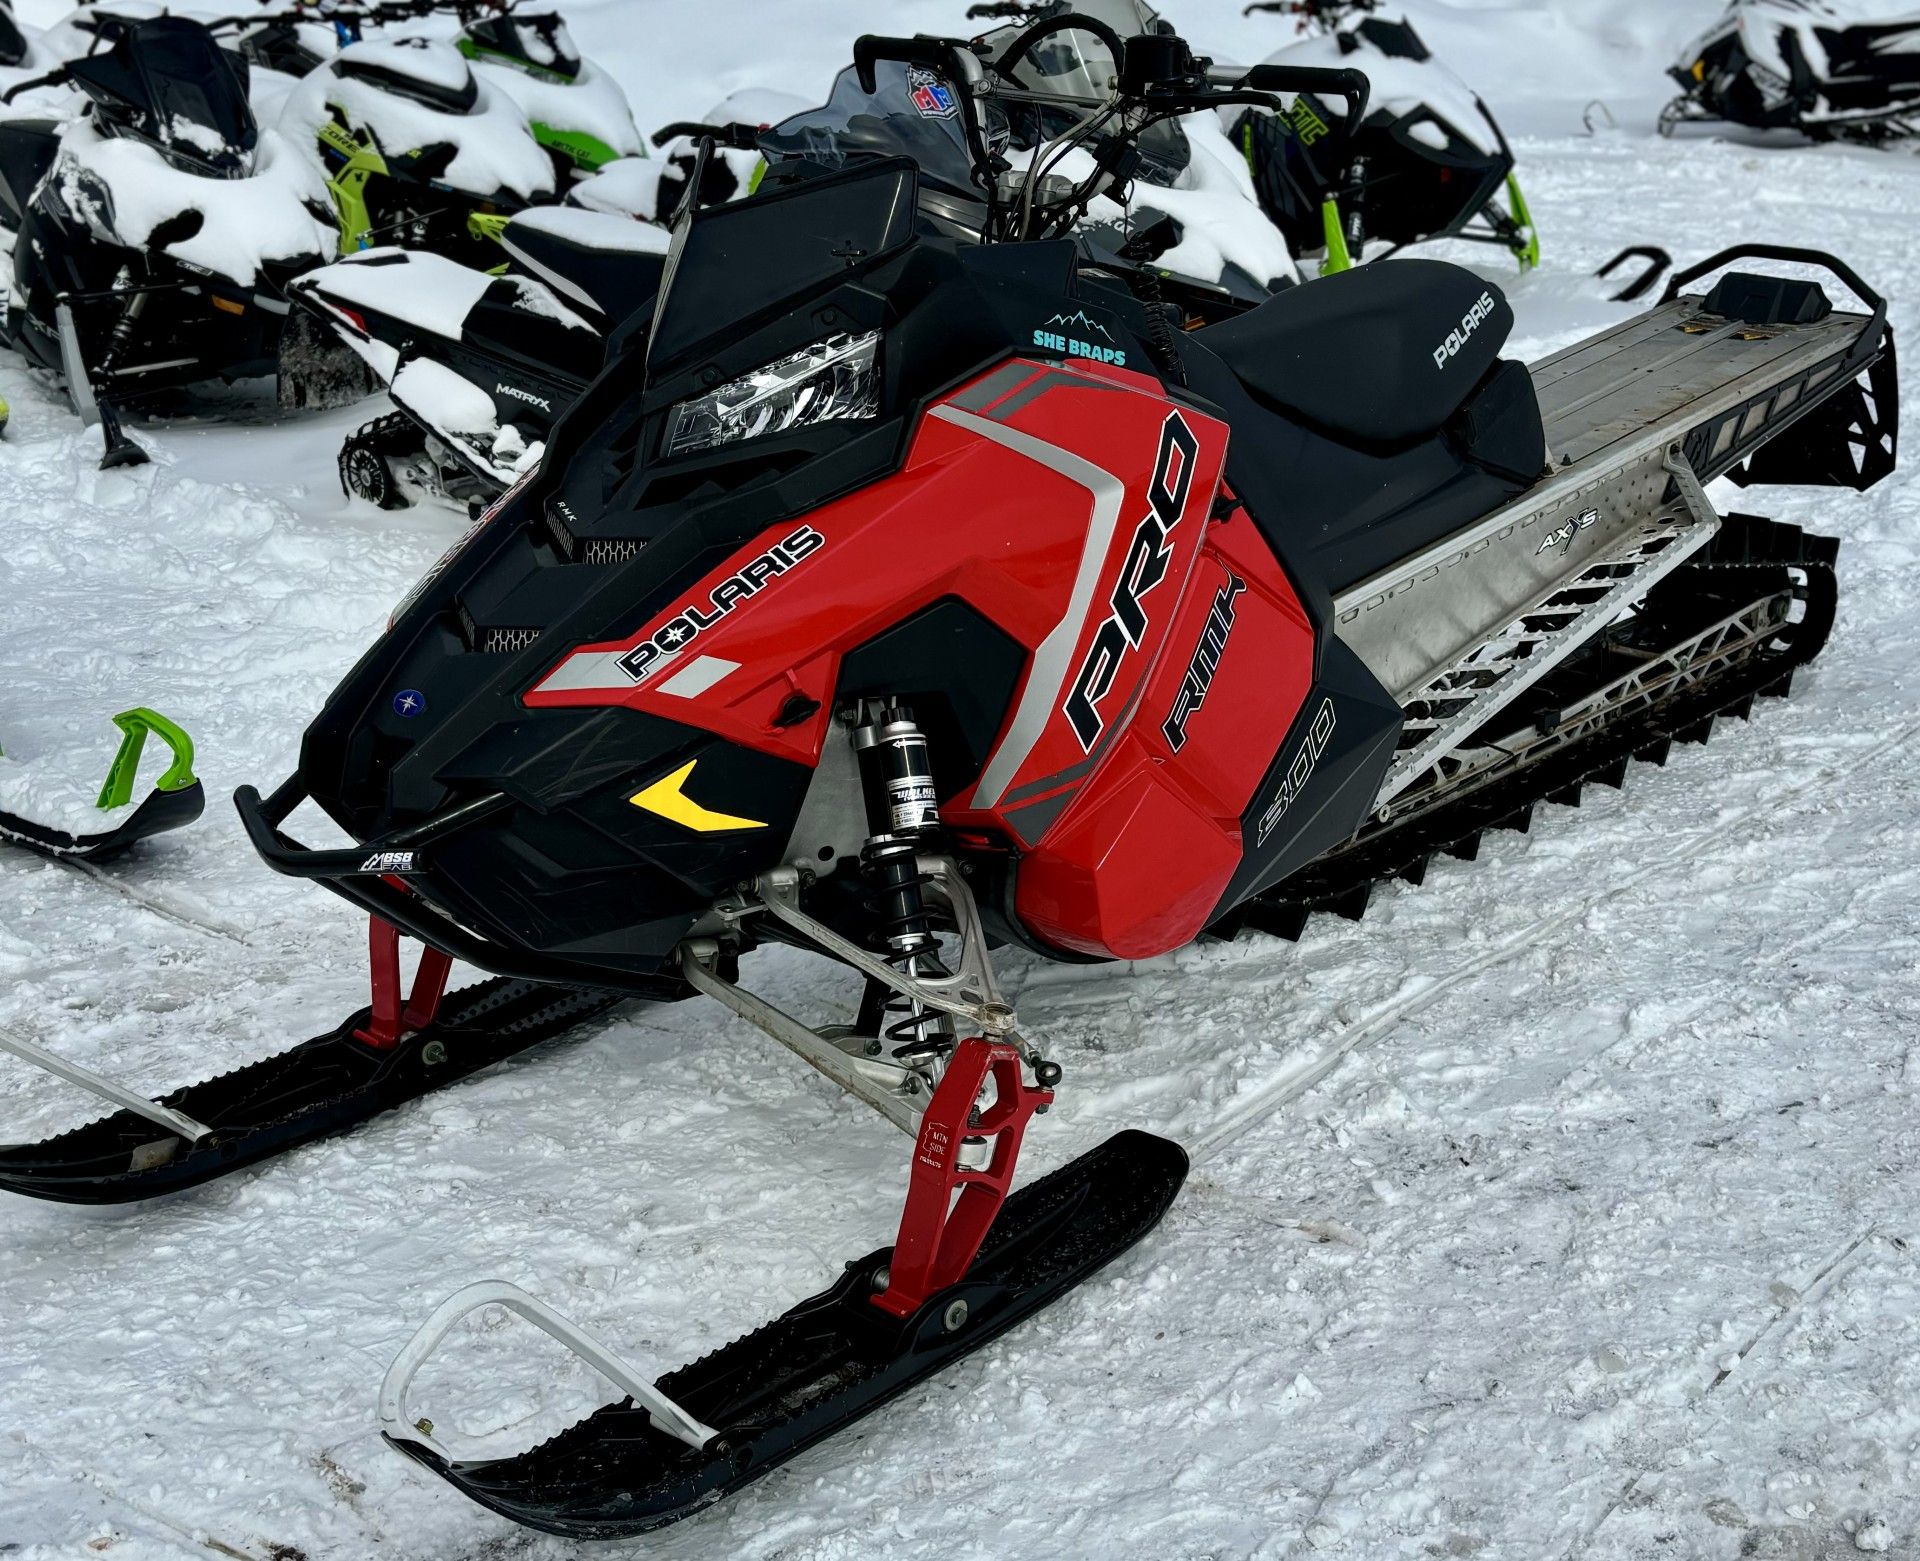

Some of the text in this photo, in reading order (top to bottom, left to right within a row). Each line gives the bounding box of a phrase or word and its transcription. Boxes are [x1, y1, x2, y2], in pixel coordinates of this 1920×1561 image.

[576, 148, 592, 160] CAT
[1033, 329, 1126, 366] SHE BRAPS
[1432, 290, 1495, 370] POLARIS
[495, 382, 551, 413] MATRYX
[557, 501, 577, 522] RMK
[1535, 506, 1599, 557] AXYS
[1063, 407, 1200, 756] PRO
[614, 523, 826, 683] POLARIS
[1160, 550, 1248, 754] RMK
[1257, 697, 1337, 849] 800
[383, 851, 414, 863] BSB
[929, 1142, 946, 1156] SIDE
[933, 1131, 948, 1144] MTN
